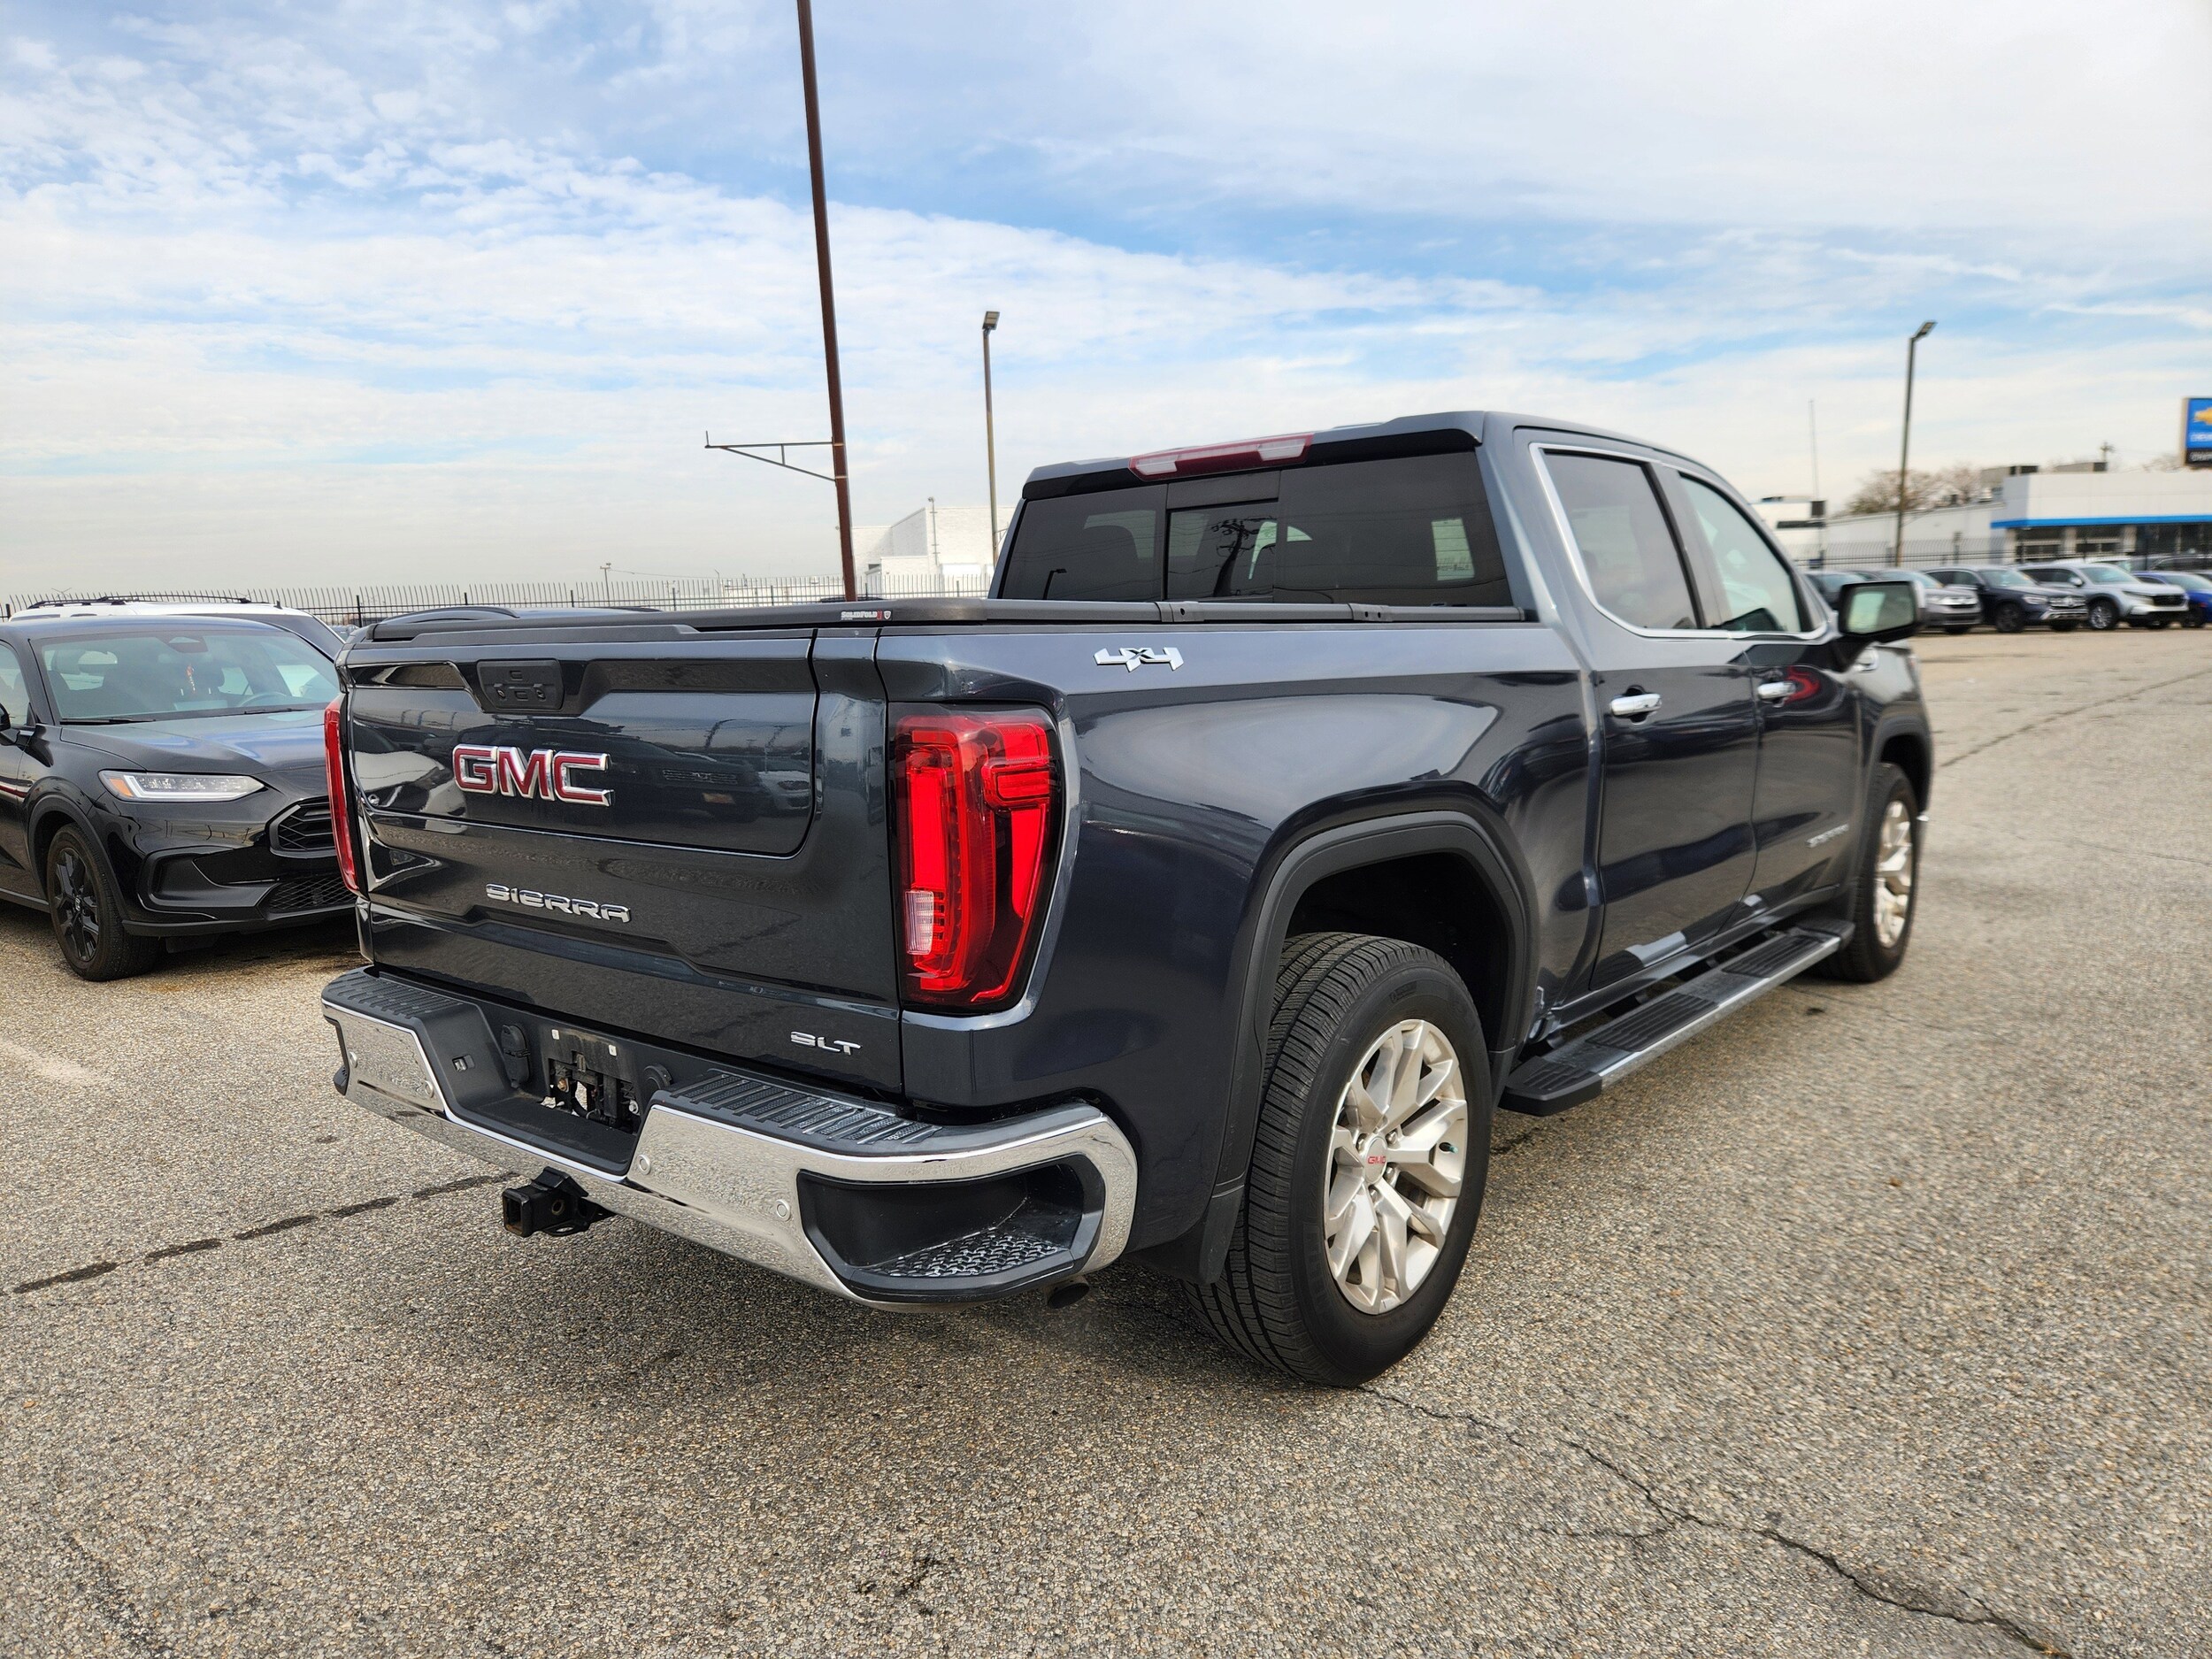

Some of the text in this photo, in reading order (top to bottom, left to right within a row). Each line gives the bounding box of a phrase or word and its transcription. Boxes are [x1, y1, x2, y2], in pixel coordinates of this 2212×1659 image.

[452, 743, 615, 807] GMC
[486, 883, 631, 923] SIERRA
[790, 1031, 861, 1056] SLT
[1367, 1156, 1386, 1164] GMC
